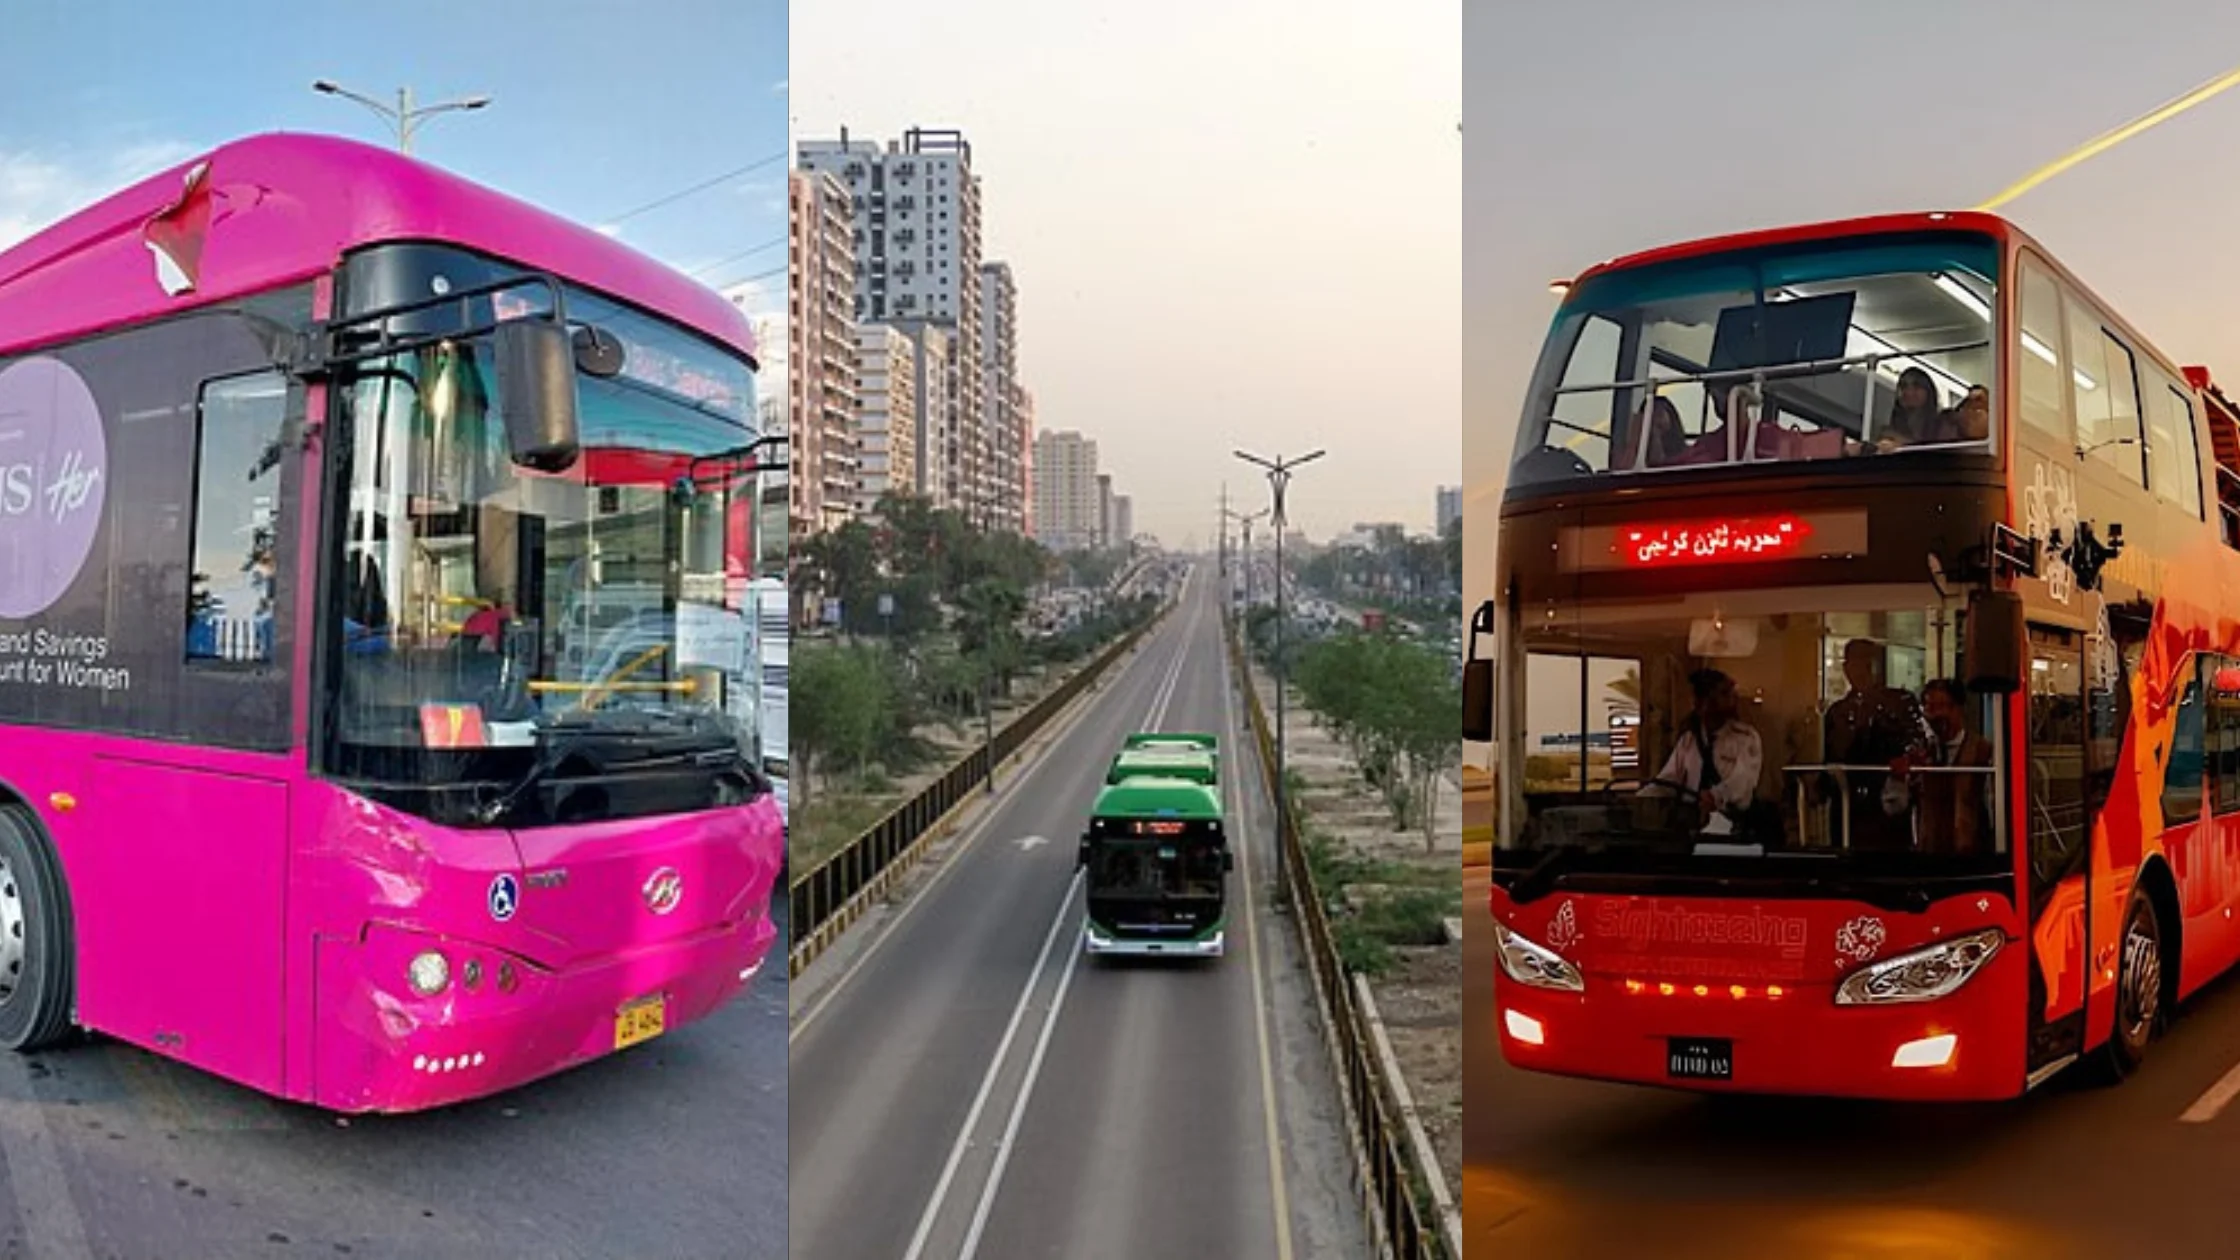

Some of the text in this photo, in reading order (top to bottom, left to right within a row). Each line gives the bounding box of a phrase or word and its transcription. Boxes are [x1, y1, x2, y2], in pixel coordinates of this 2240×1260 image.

[45, 450, 99, 524] Her
[0, 628, 107, 663] and Savings
[28, 659, 52, 684] for
[56, 661, 130, 690] Women
